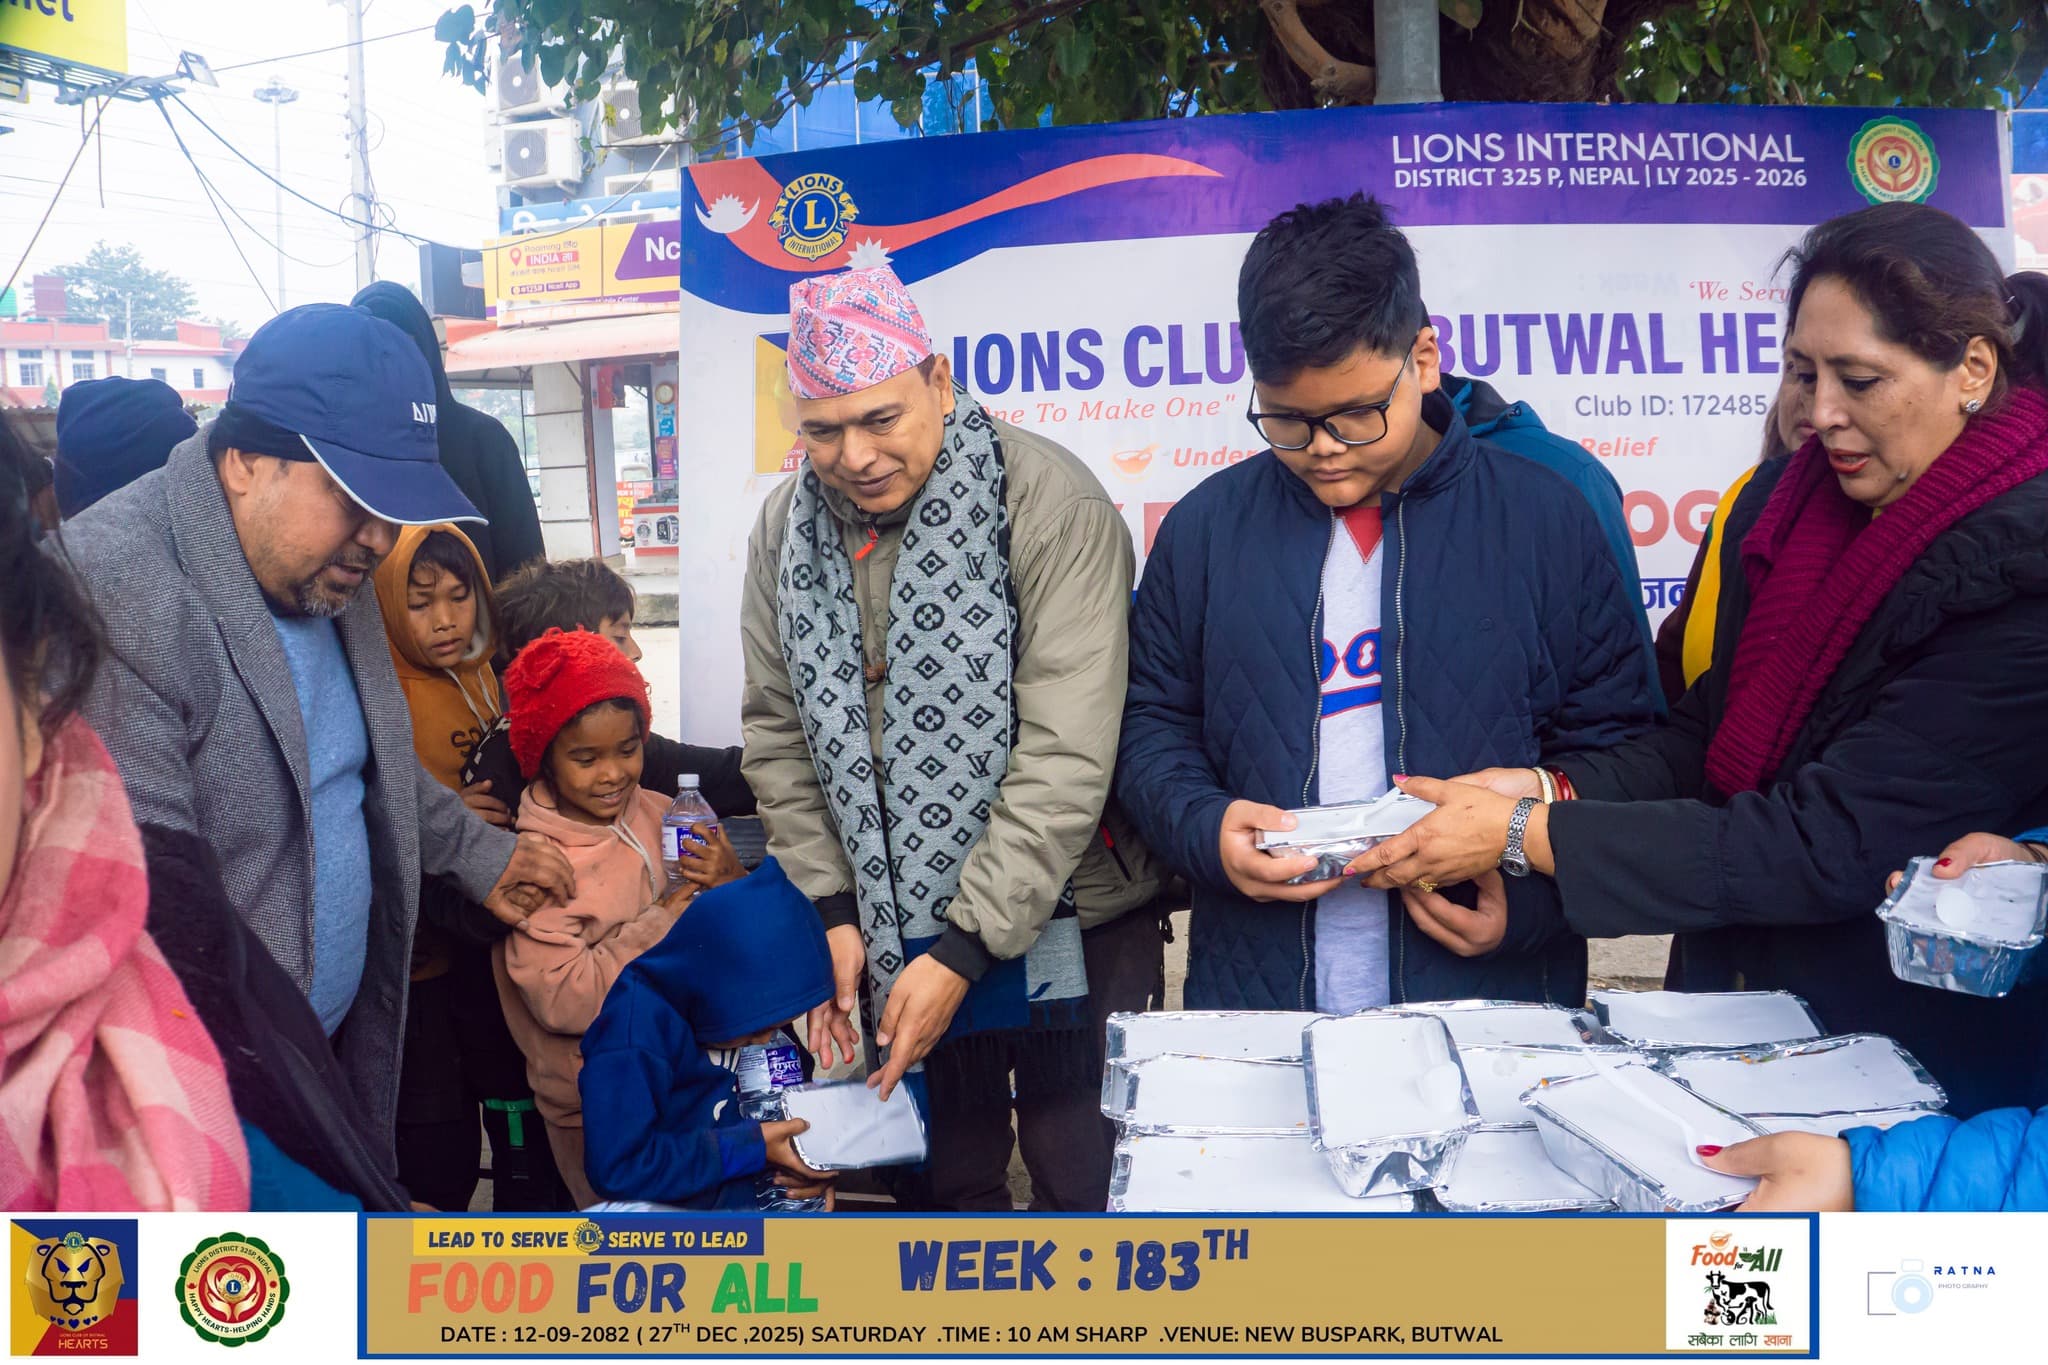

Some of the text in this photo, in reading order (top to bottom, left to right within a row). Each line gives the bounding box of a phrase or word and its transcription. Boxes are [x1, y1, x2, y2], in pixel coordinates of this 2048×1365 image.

[1392, 132, 1805, 164] LIONS INTERNATIONAL
[788, 175, 840, 196] LIONS
[1394, 167, 1496, 188] DISTRICT
[1502, 167, 1542, 186] 325
[1547, 168, 1563, 188] P,
[1569, 167, 1640, 186] NEPAL
[1657, 167, 1681, 186] LY
[1686, 167, 1738, 186] 2025
[1755, 168, 1807, 187] 2026
[804, 199, 827, 230] L
[788, 236, 840, 254] INTERNATIONAL
[530, 251, 559, 264] INDIA
[1123, 322, 1245, 389] CLU
[1036, 403, 1067, 423] To
[1077, 399, 1155, 422] Make
[1575, 394, 1768, 416] Club ID: 172485
[1580, 436, 1660, 457] Relief
